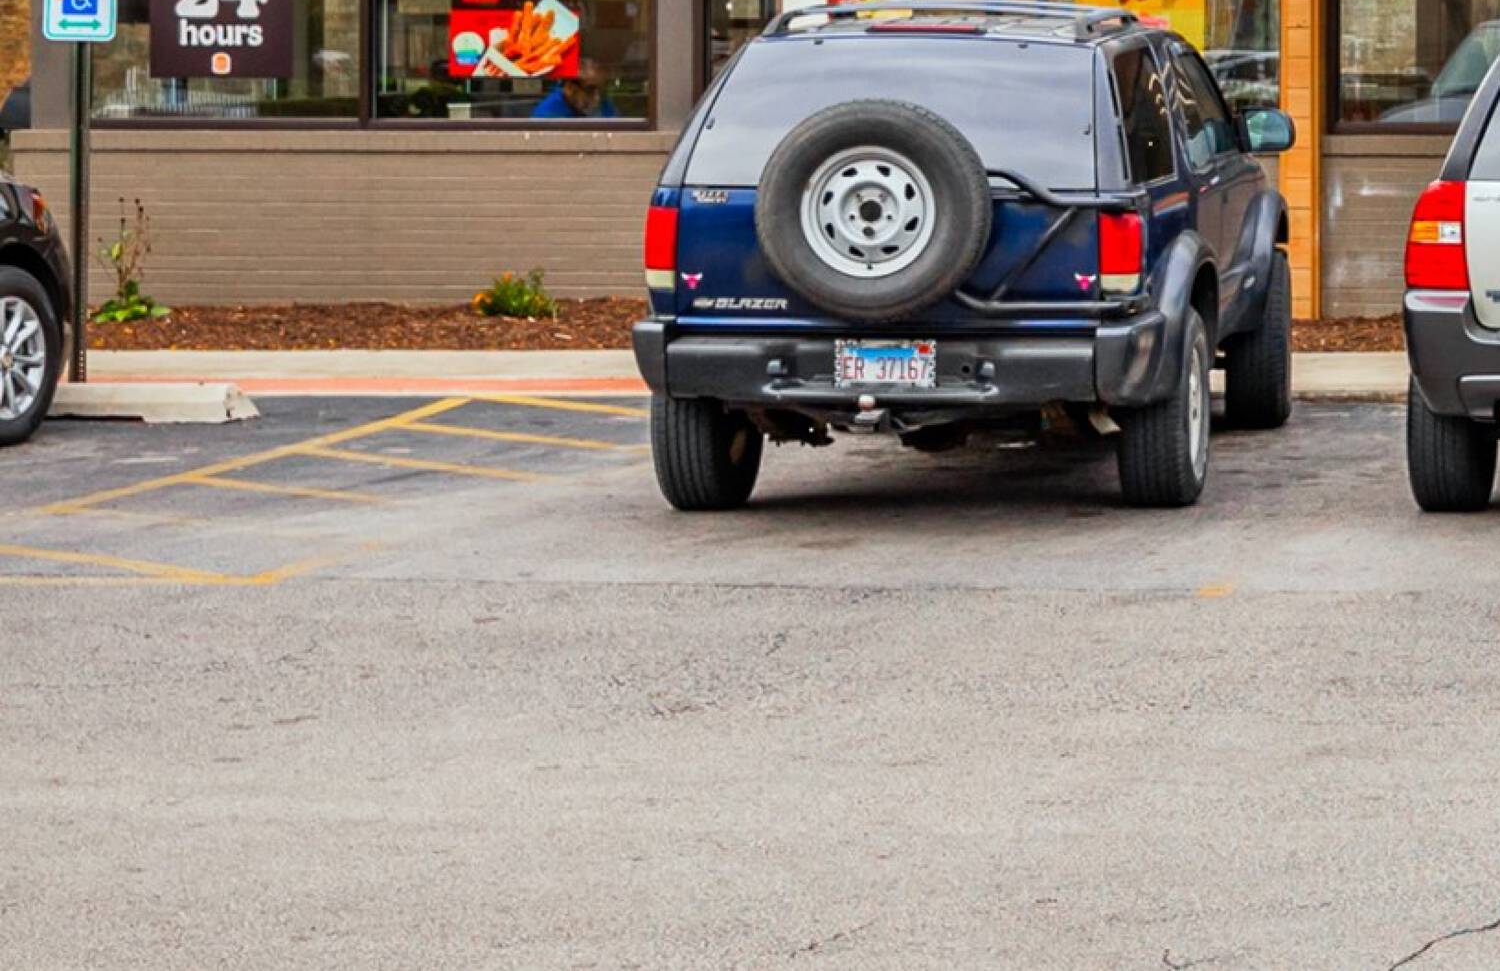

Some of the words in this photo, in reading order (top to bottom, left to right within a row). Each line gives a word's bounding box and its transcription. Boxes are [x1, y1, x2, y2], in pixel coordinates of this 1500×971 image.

[179, 19, 264, 47] hours
[715, 297, 788, 310] BLAZER
[842, 356, 865, 380] ER
[875, 356, 929, 380] 37167
